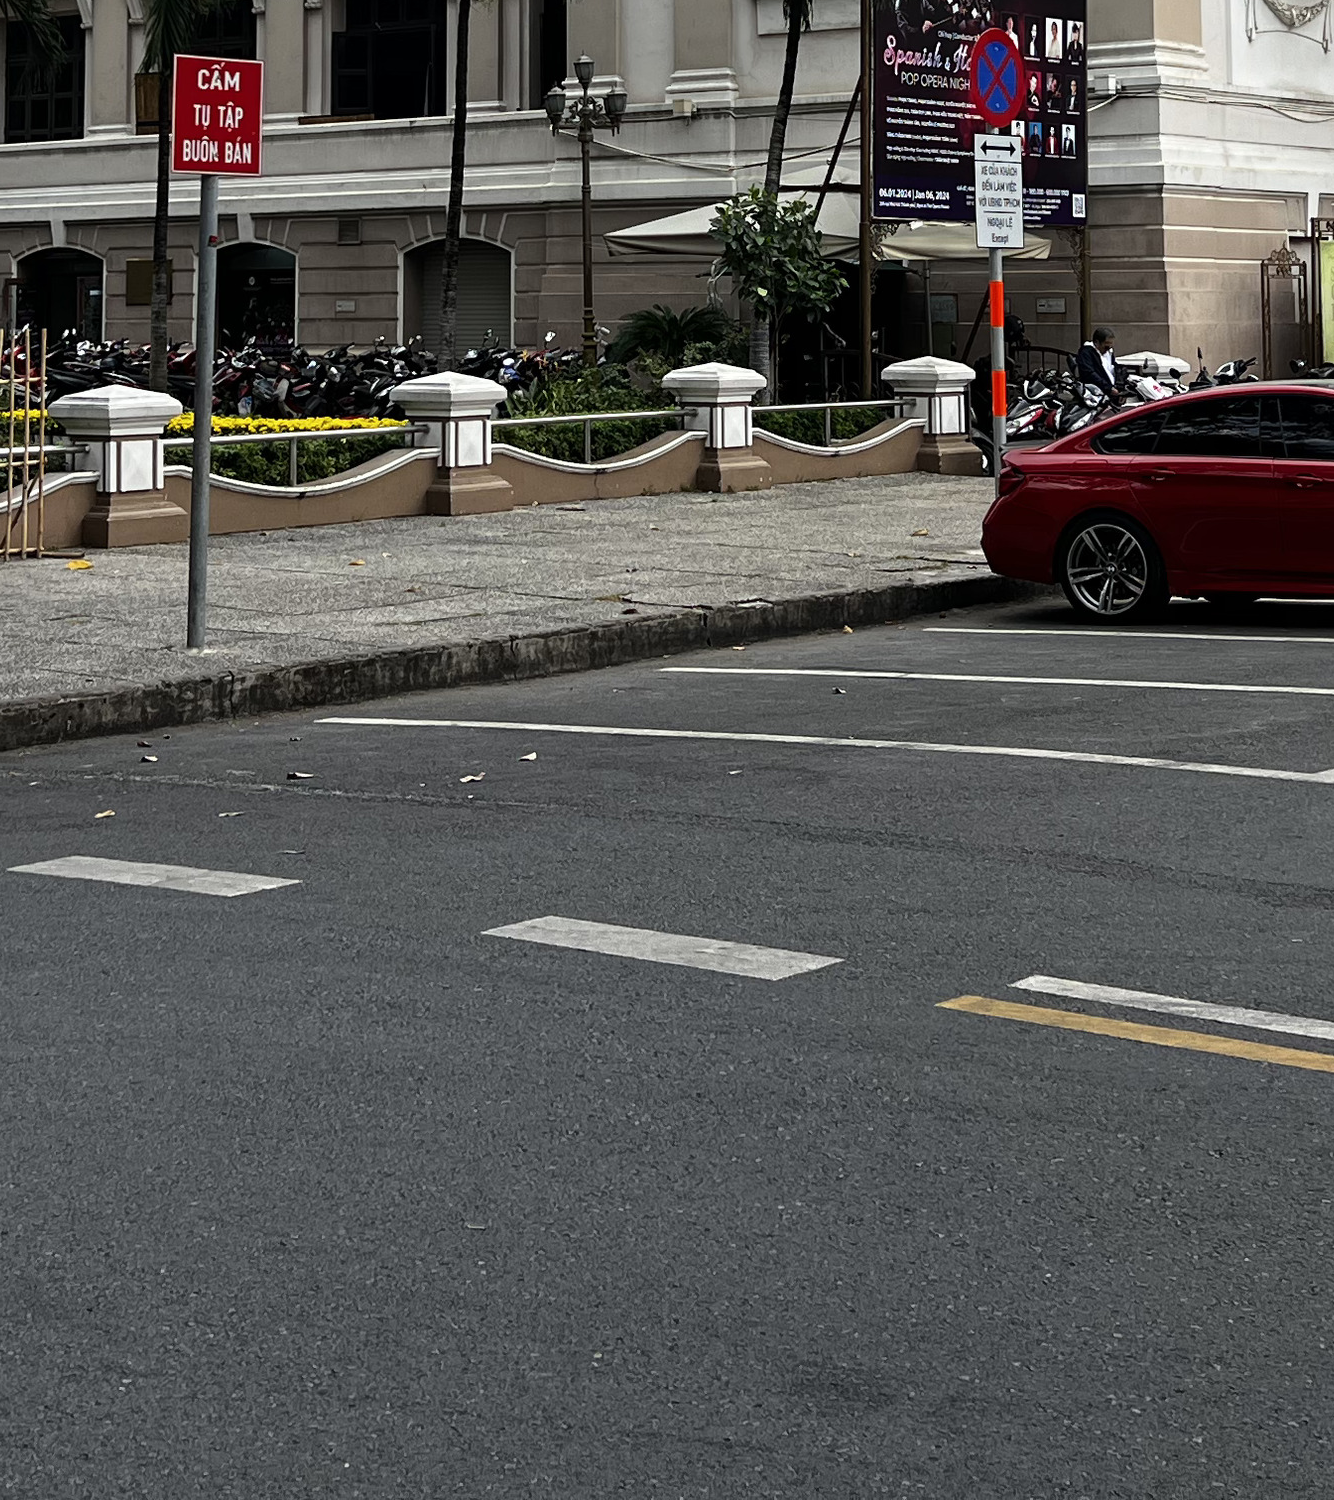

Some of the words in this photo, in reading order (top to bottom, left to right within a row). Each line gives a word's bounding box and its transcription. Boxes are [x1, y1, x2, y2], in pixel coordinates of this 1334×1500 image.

[884, 35, 943, 76] Spanish
[197, 62, 241, 92] CẤM
[900, 71, 919, 86] POP
[921, 73, 948, 89] OPERA
[950, 77, 971, 91] NIGH
[193, 104, 211, 131] TỤ
[218, 101, 244, 132] TẬP
[183, 135, 219, 163] BUÔN
[224, 136, 252, 164] BÁN
[999, 165, 1017, 176] KHÁCH
[879, 188, 912, 198] 06.01.2024
[915, 190, 925, 199] Jan
[935, 191, 950, 201] 2024
[1005, 181, 1017, 194] VIỆC
[987, 217, 1005, 230] NGOẠI
